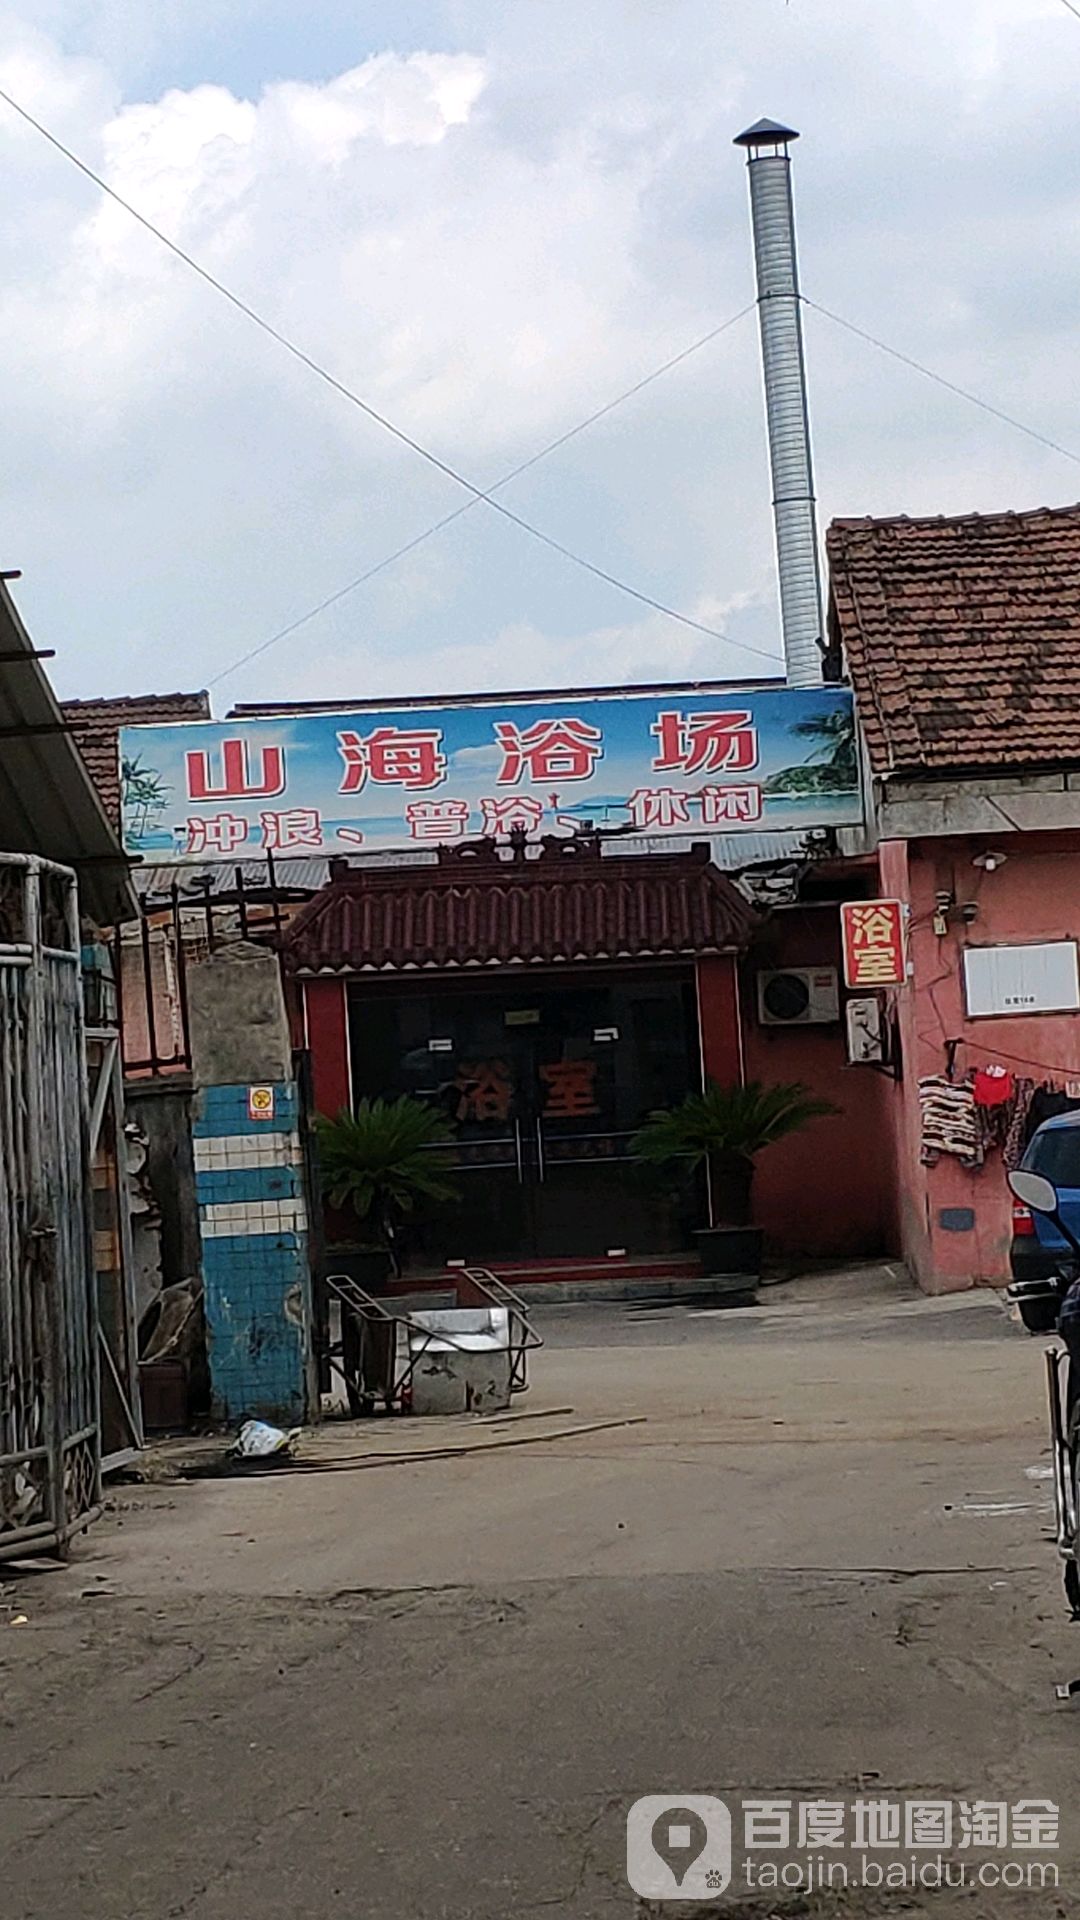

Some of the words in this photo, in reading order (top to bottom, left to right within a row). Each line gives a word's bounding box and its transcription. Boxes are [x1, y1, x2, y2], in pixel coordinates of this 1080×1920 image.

[186, 711, 759, 799] 山海浴场
[852, 906, 897, 983] 浴室
[456, 1059, 599, 1121] 浴室
